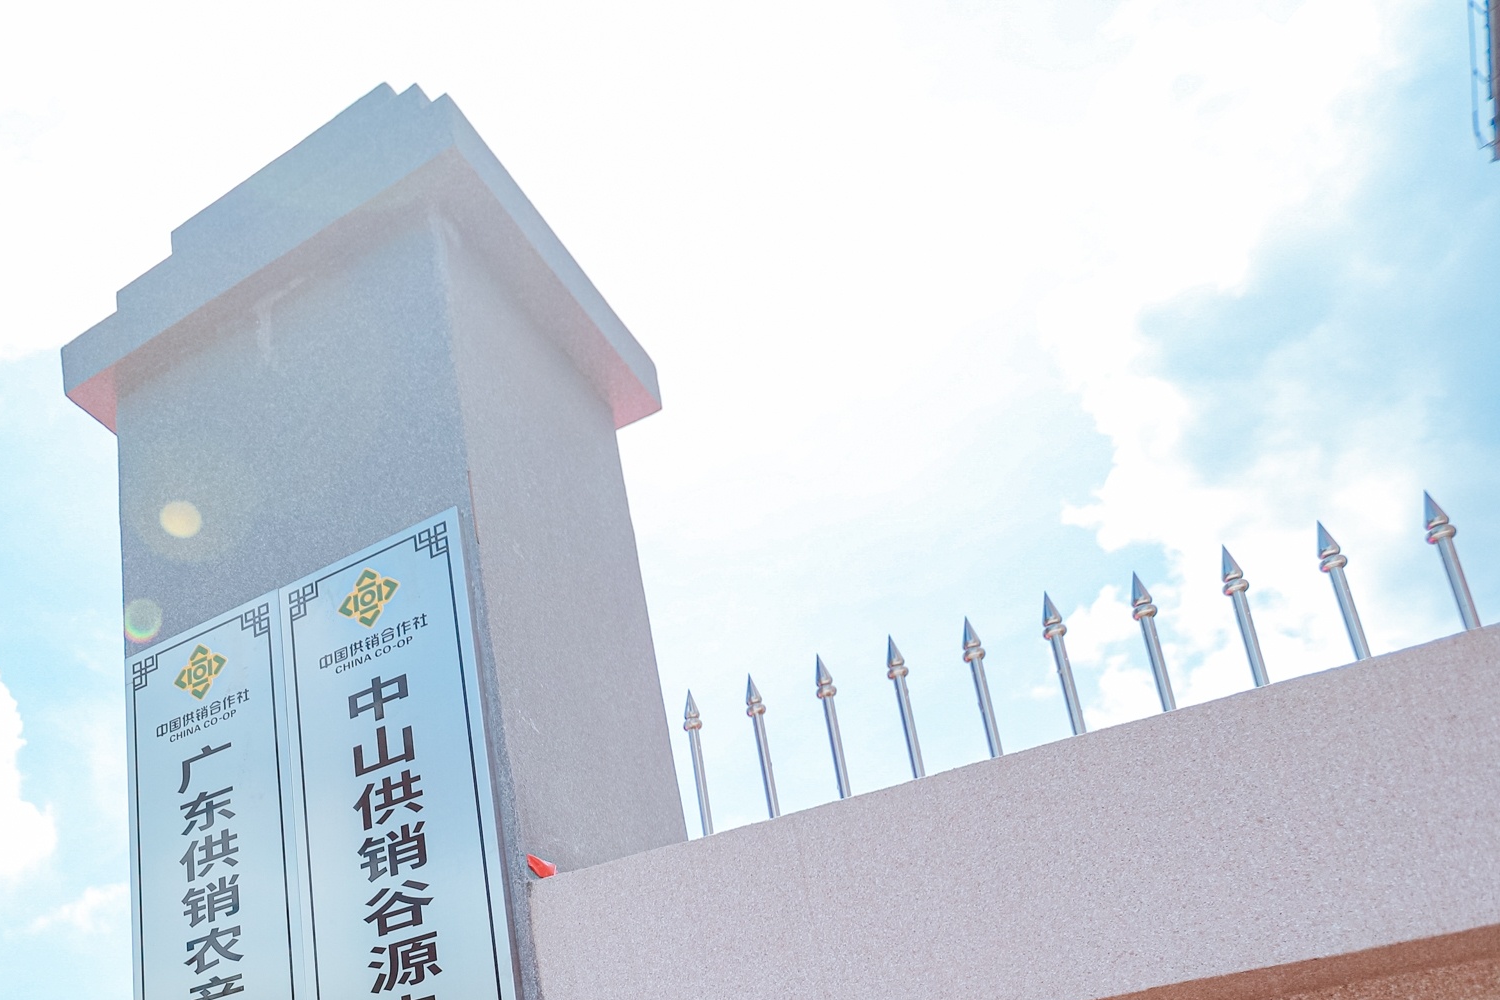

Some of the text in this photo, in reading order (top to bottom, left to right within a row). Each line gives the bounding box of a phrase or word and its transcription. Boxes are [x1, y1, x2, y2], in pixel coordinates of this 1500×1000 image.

[318, 613, 429, 669] 中国供销合作社
[335, 635, 414, 674] CHINA CO-OP
[156, 688, 250, 738] 中国供销合作社
[169, 709, 237, 743] CHINA CO-OP
